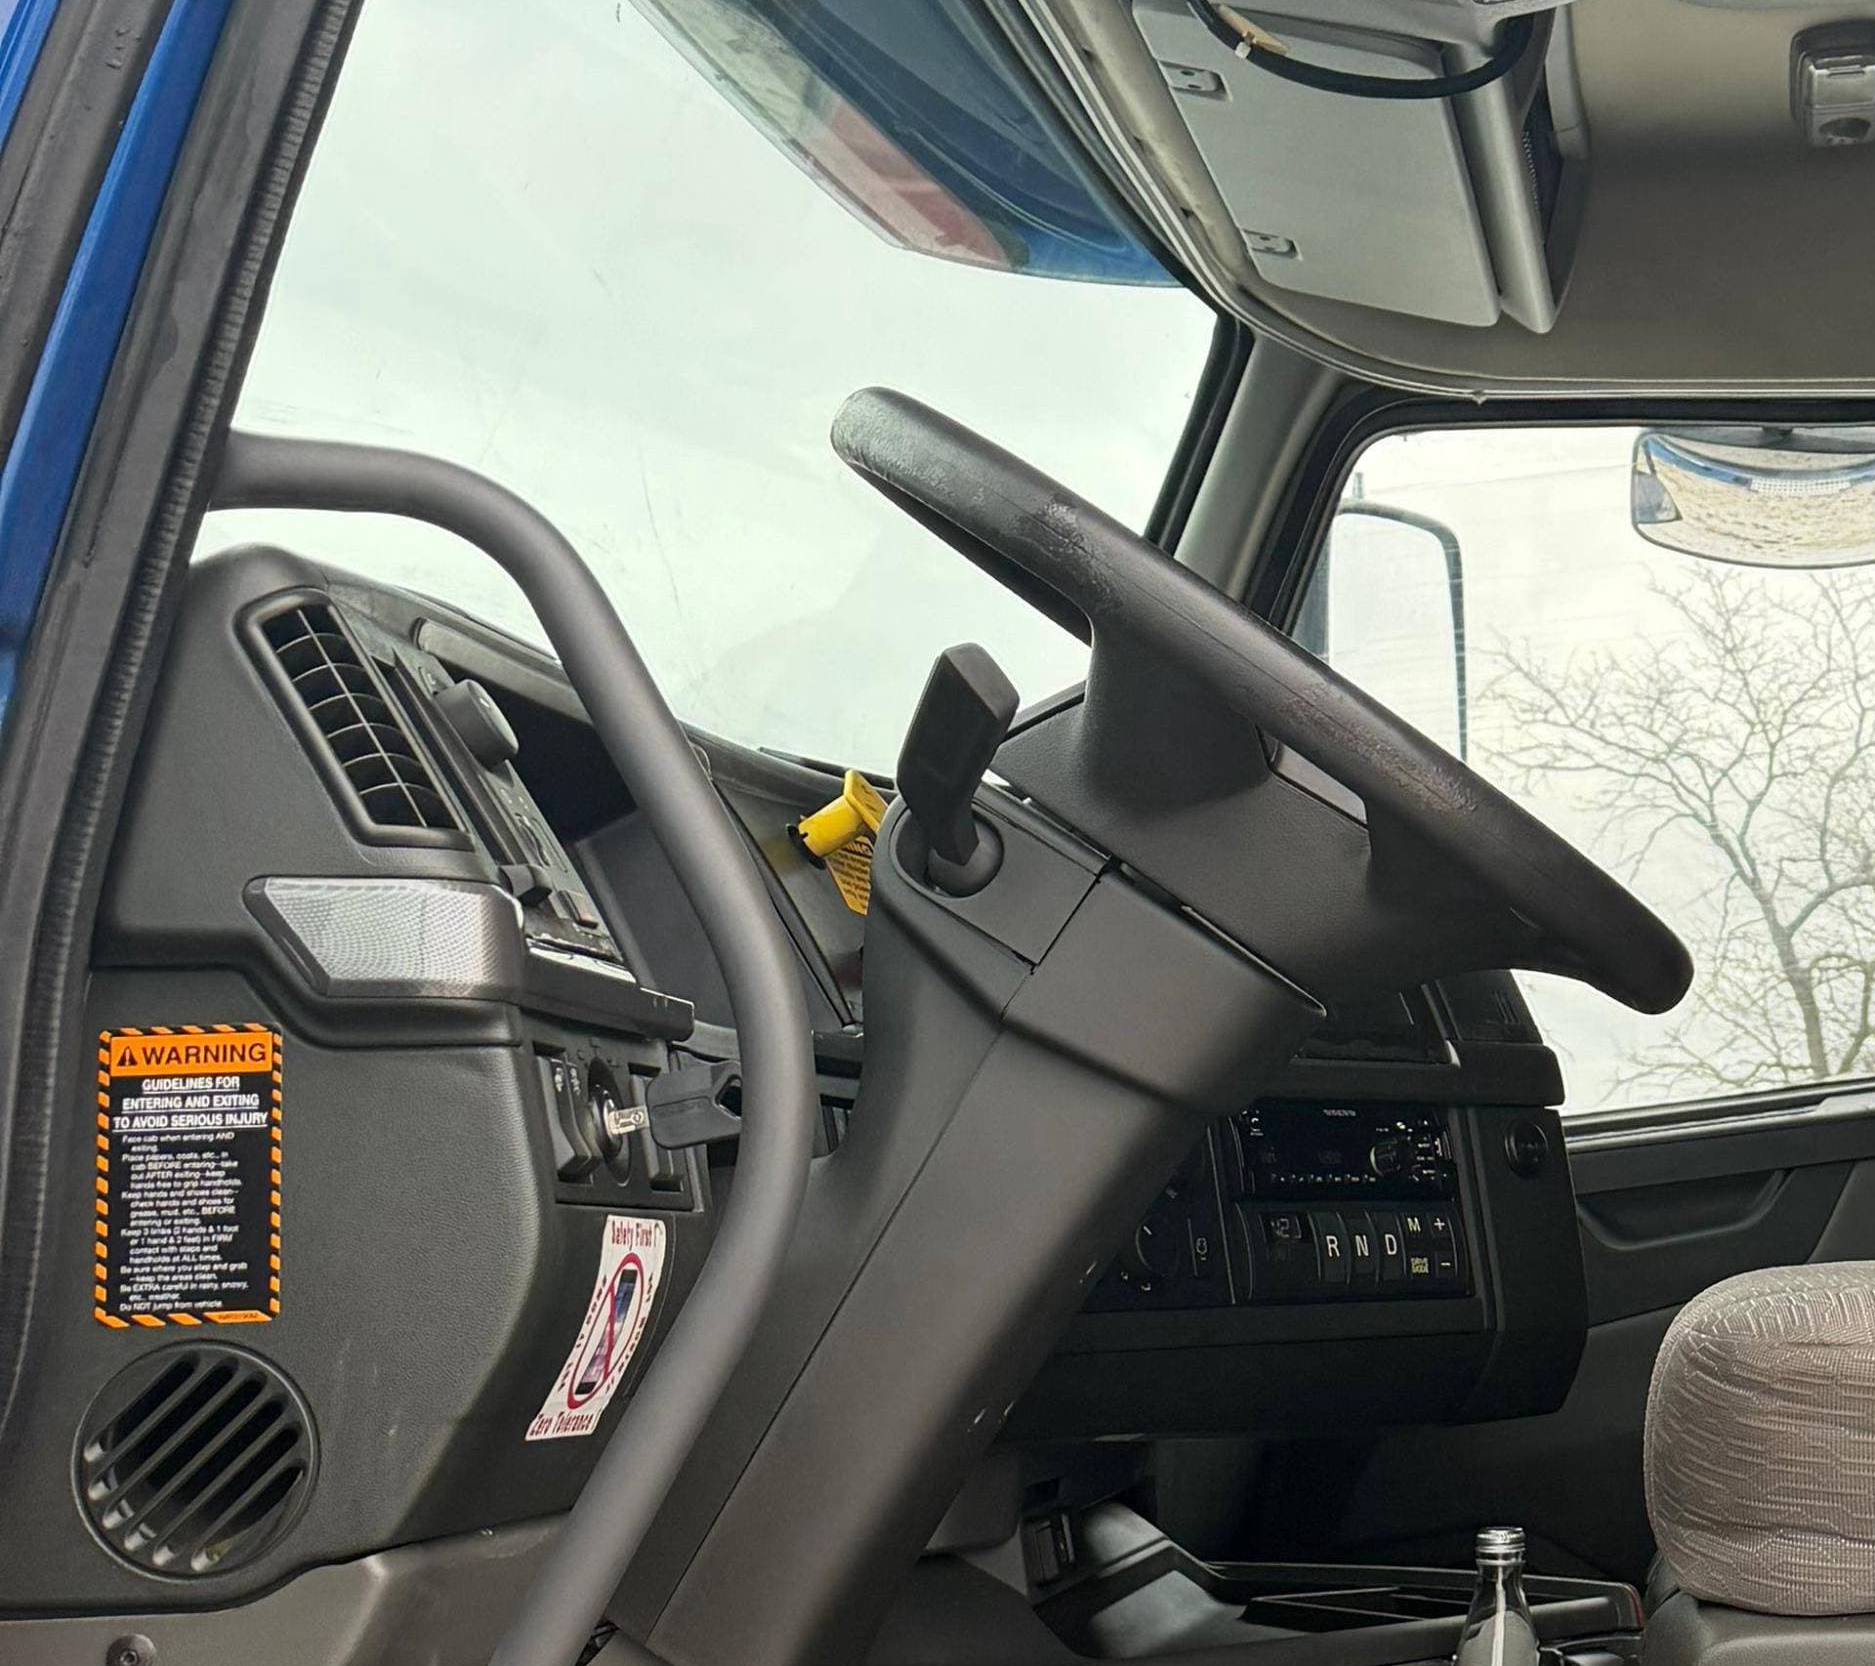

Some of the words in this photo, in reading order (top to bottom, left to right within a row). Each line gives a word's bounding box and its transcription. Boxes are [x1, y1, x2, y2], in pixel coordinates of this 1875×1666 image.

[142, 1043, 266, 1065] WARNING
[142, 1078, 213, 1091] GUIDELINES
[216, 1076, 240, 1089] FOR
[122, 1097, 182, 1111] ENTERING
[185, 1096, 209, 1108] AND
[213, 1094, 260, 1106] EXITING
[113, 1117, 129, 1128] TO
[132, 1115, 168, 1128] AVOID
[171, 1114, 223, 1126] SERIOUS
[225, 1112, 268, 1125] INJURY
[122, 1135, 141, 1143] Face
[182, 1134, 214, 1142] entering
[148, 1162, 181, 1170] BEFORE
[184, 1181, 198, 1189] grip
[122, 1191, 141, 1199] Keep
[144, 1190, 167, 1198] hands
[187, 1189, 209, 1197] shoes
[131, 1200, 153, 1208] check
[156, 1199, 179, 1207] hands
[182, 1198, 196, 1206] and
[201, 1206, 236, 1215] BEFORE
[130, 1219, 162, 1227] entering
[1407, 1217, 1421, 1233] M
[182, 1226, 206, 1234] hands
[612, 1220, 634, 1250] Safety
[635, 1222, 653, 1248] First
[146, 1237, 166, 1245] hand
[212, 1234, 233, 1242] FIRM
[180, 1245, 200, 1253] steps
[1327, 1235, 1340, 1257] R
[1355, 1235, 1370, 1257] N
[1385, 1234, 1398, 1256] D
[130, 1255, 170, 1263] handholds
[177, 1265, 192, 1273] you
[194, 1264, 211, 1272] step
[229, 1262, 247, 1271] grab
[133, 1283, 160, 1291] EXTRA
[162, 1282, 188, 1290] careful
[153, 1302, 172, 1311] jump
[530, 1414, 553, 1437] Zero
[553, 1412, 593, 1435] Tolerance
